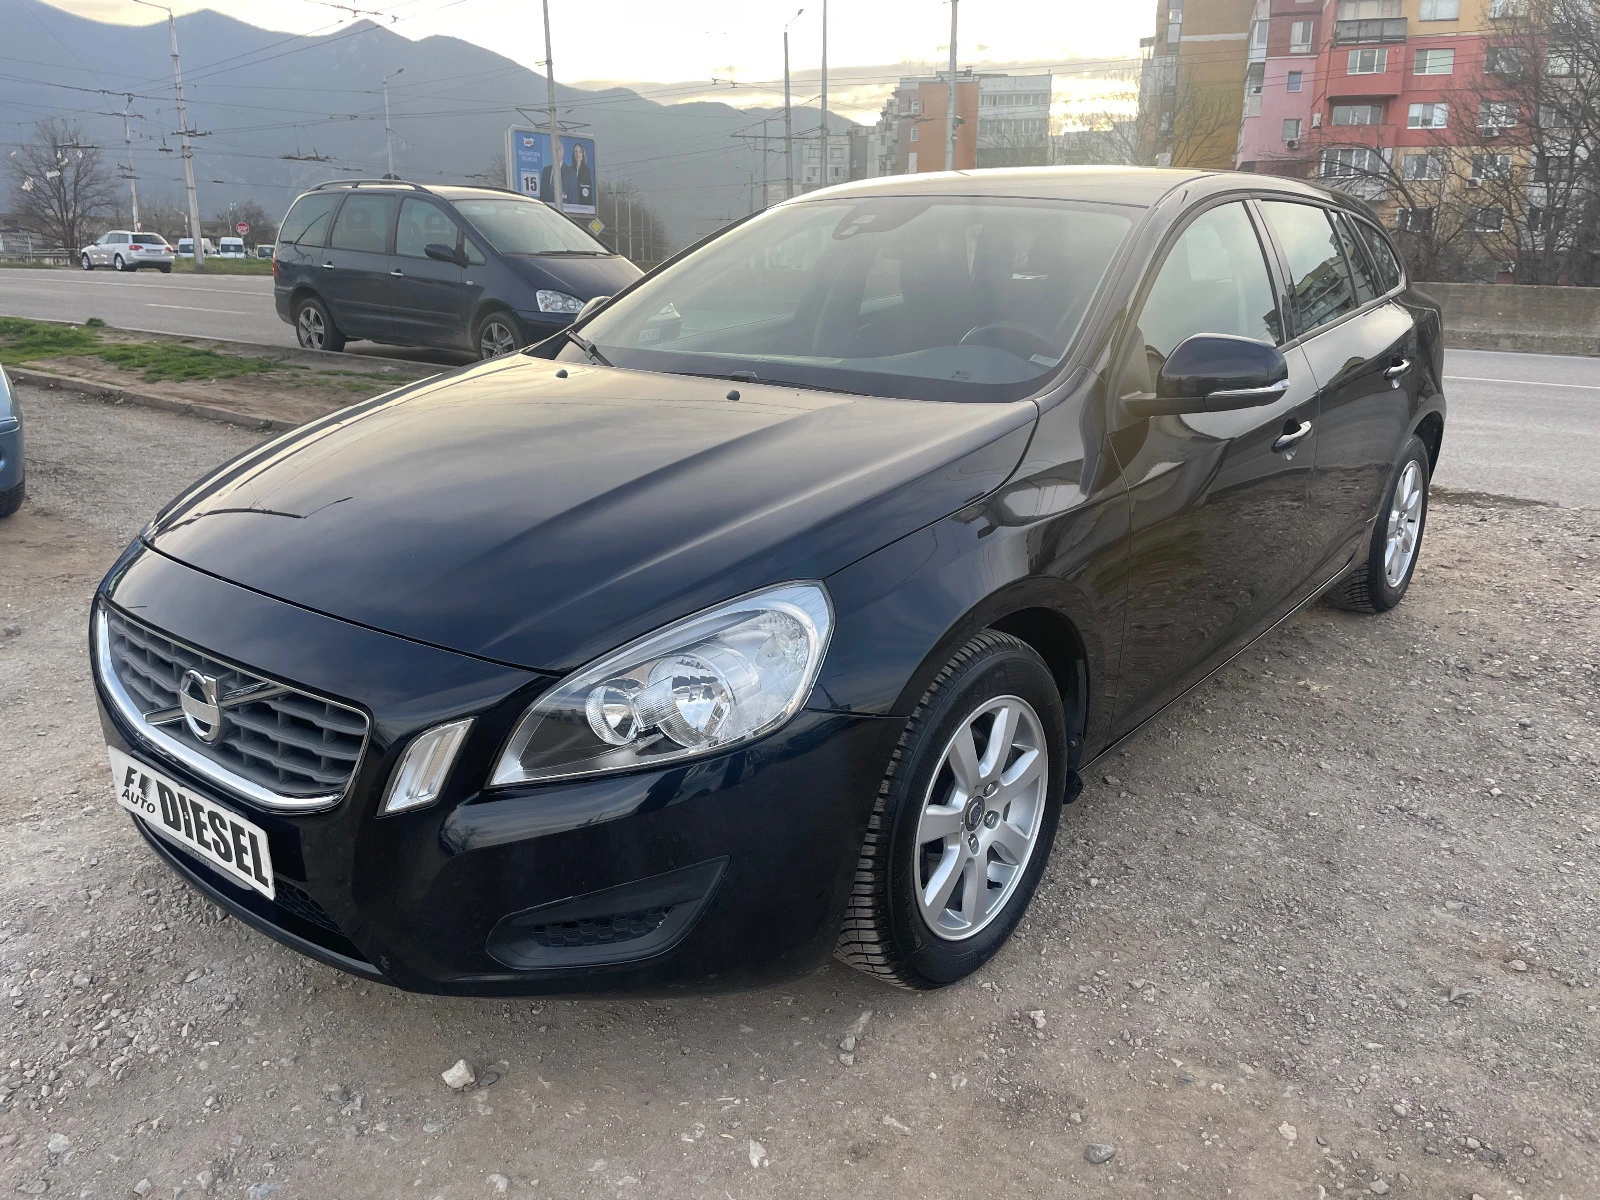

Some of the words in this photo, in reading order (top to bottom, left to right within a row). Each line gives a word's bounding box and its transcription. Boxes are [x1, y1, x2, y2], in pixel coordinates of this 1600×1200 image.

[524, 176, 538, 192] 15
[122, 788, 156, 813] AUTO
[156, 779, 269, 889] DIESEL
